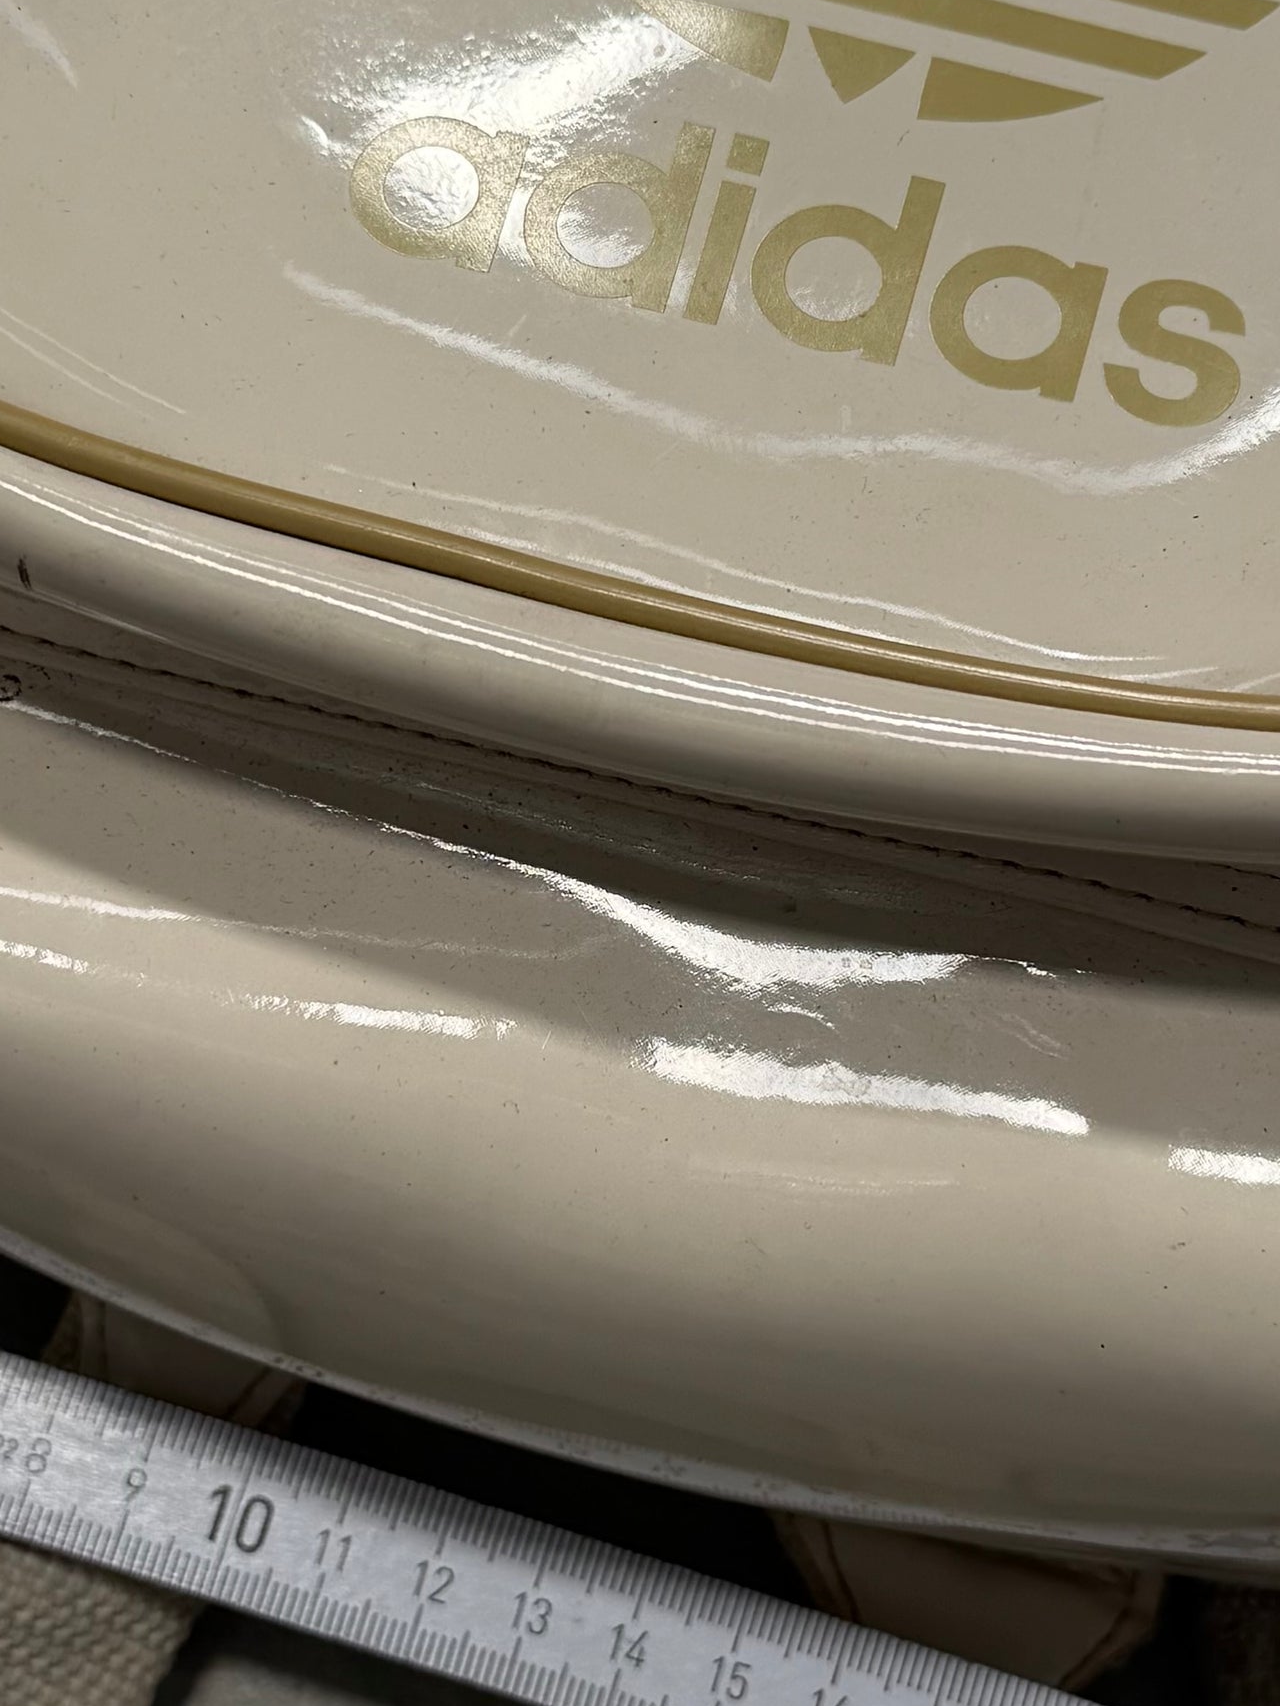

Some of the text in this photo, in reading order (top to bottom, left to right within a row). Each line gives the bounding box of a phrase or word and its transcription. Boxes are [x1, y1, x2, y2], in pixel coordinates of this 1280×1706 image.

[349, 114, 1246, 428] adidas
[25, 1437, 53, 1475] 8
[125, 1467, 148, 1503] 9
[207, 1483, 275, 1554] 10
[317, 1528, 353, 1573] 11
[414, 1559, 456, 1604] 12
[512, 1591, 554, 1636] 13
[609, 1623, 650, 1668] 14
[711, 1655, 753, 1700] 15
